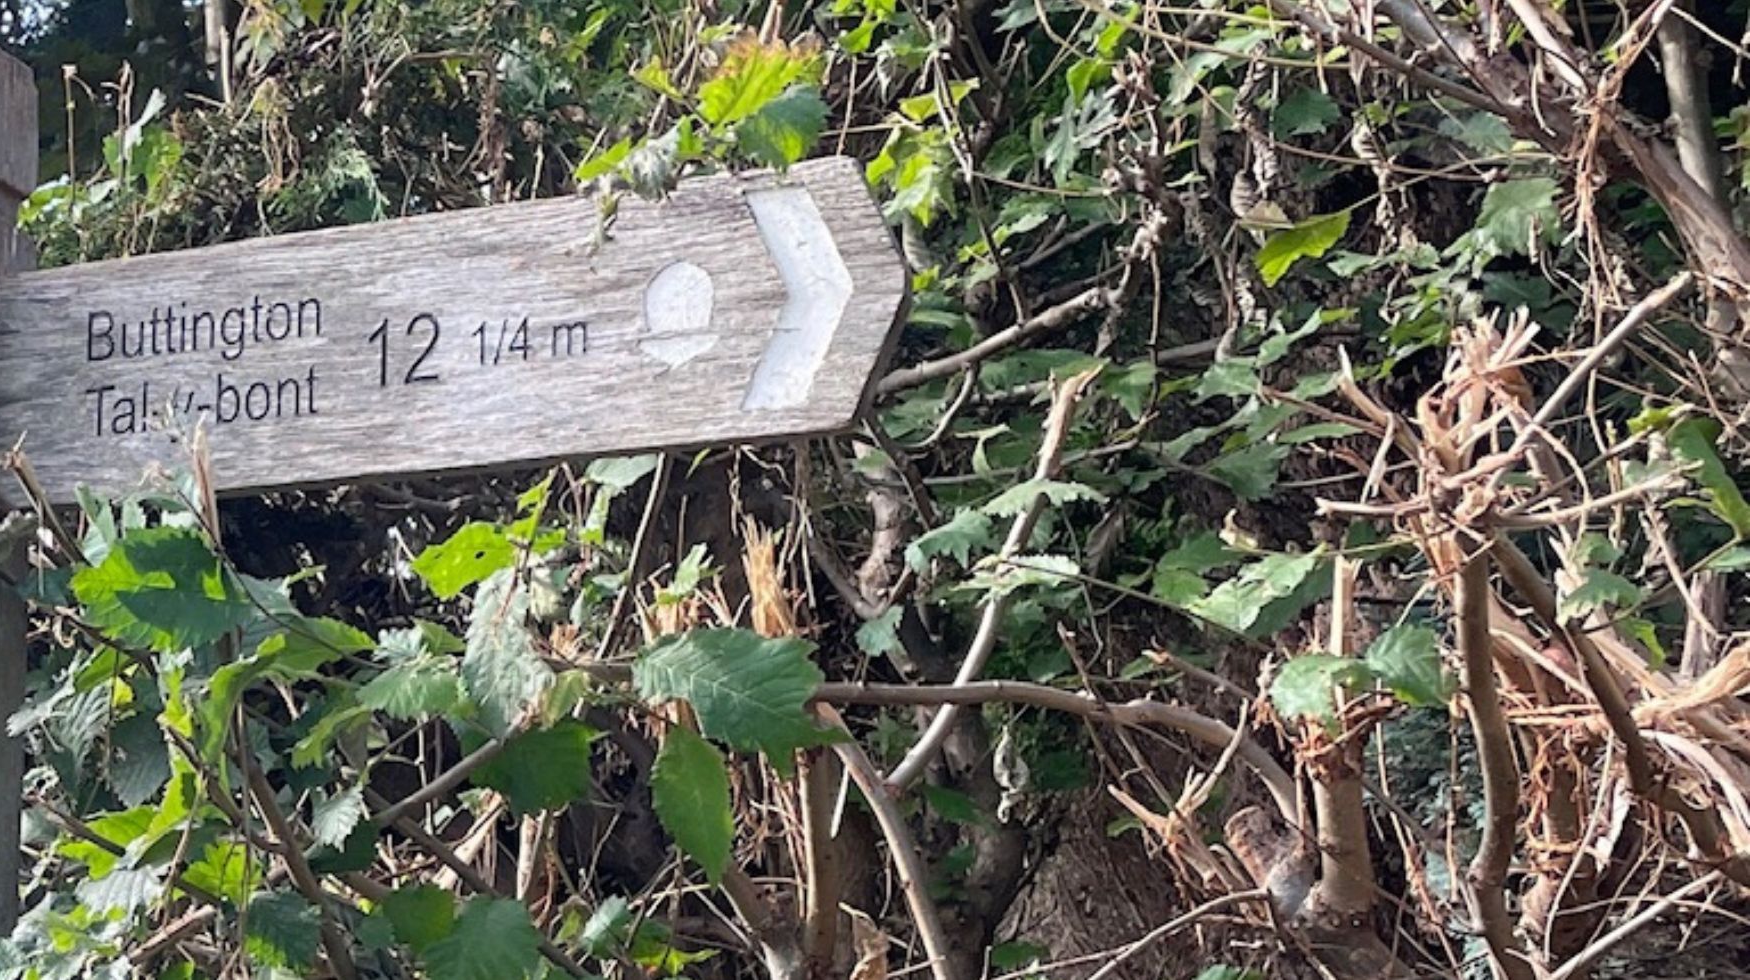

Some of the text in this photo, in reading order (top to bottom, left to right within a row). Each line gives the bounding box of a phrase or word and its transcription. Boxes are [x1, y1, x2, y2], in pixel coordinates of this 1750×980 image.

[86, 295, 322, 362] Buttington
[367, 311, 589, 387] 12 1/4 m
